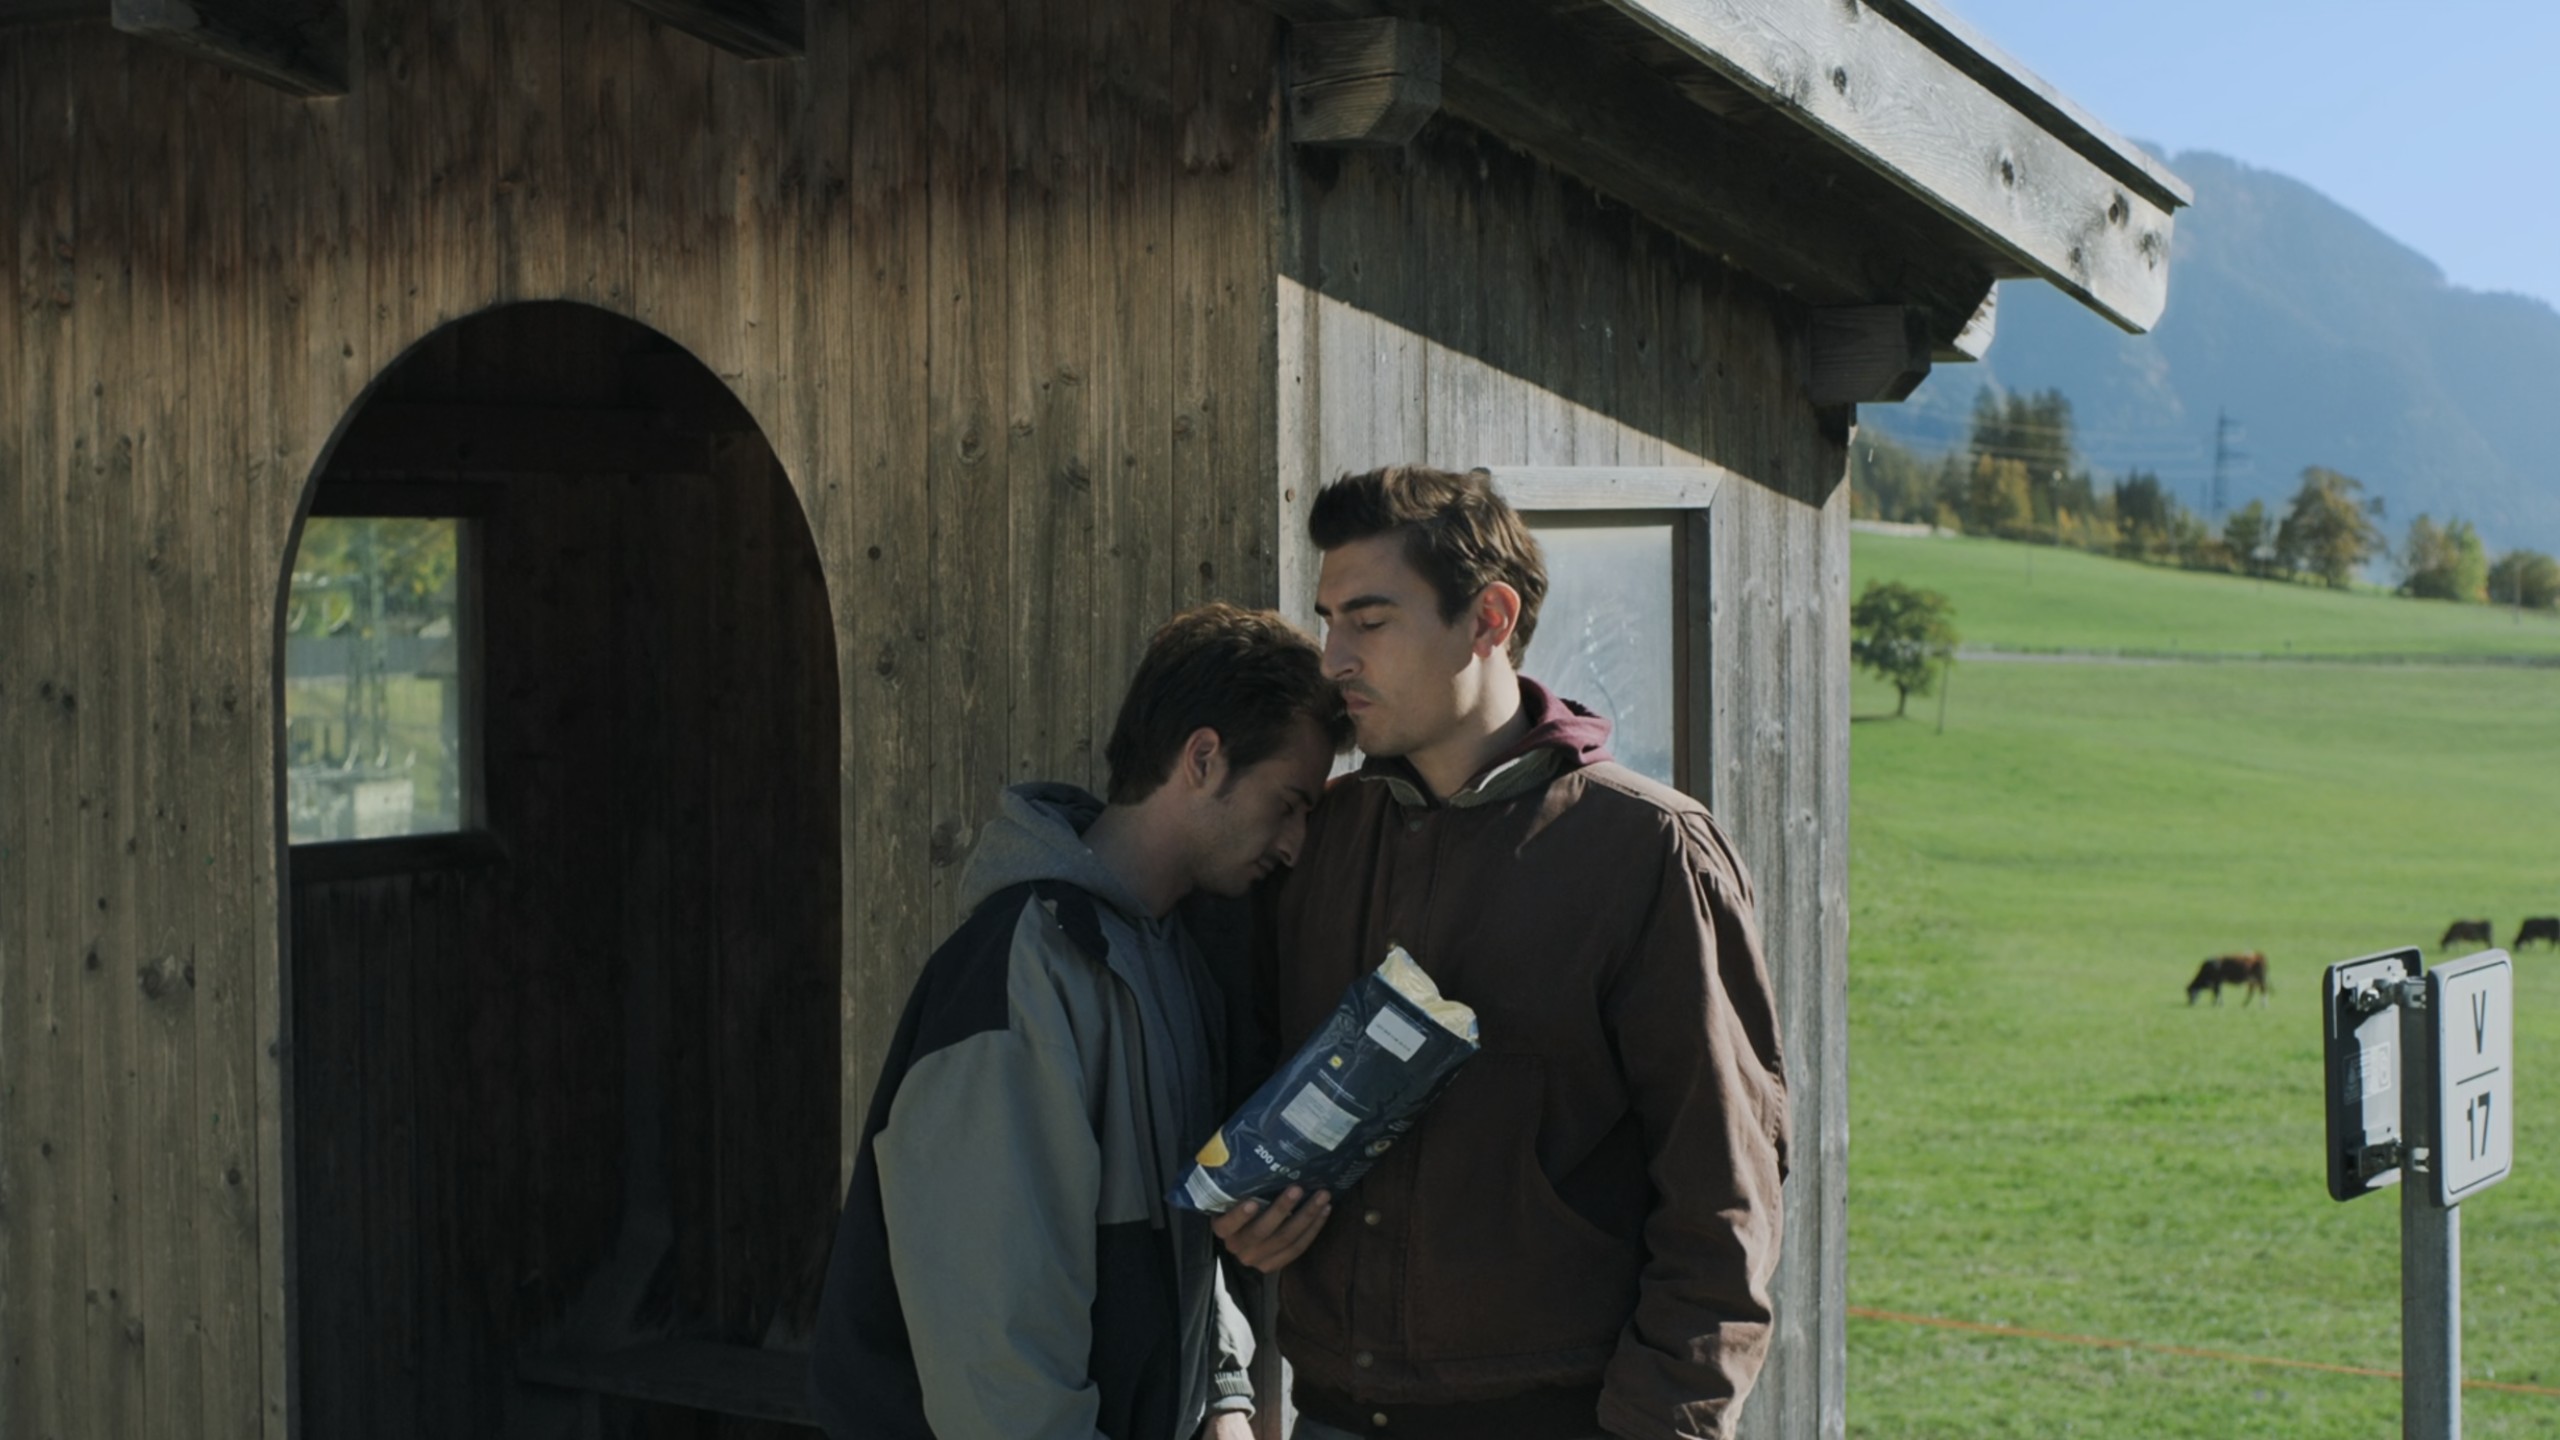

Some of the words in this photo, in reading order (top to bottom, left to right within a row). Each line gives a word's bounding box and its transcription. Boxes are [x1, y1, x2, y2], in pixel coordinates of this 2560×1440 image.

[2472, 990, 2487, 1055] V
[1253, 1144, 1275, 1165] 200
[1269, 1162, 1281, 1172] g
[2466, 1091, 2491, 1161] 17
